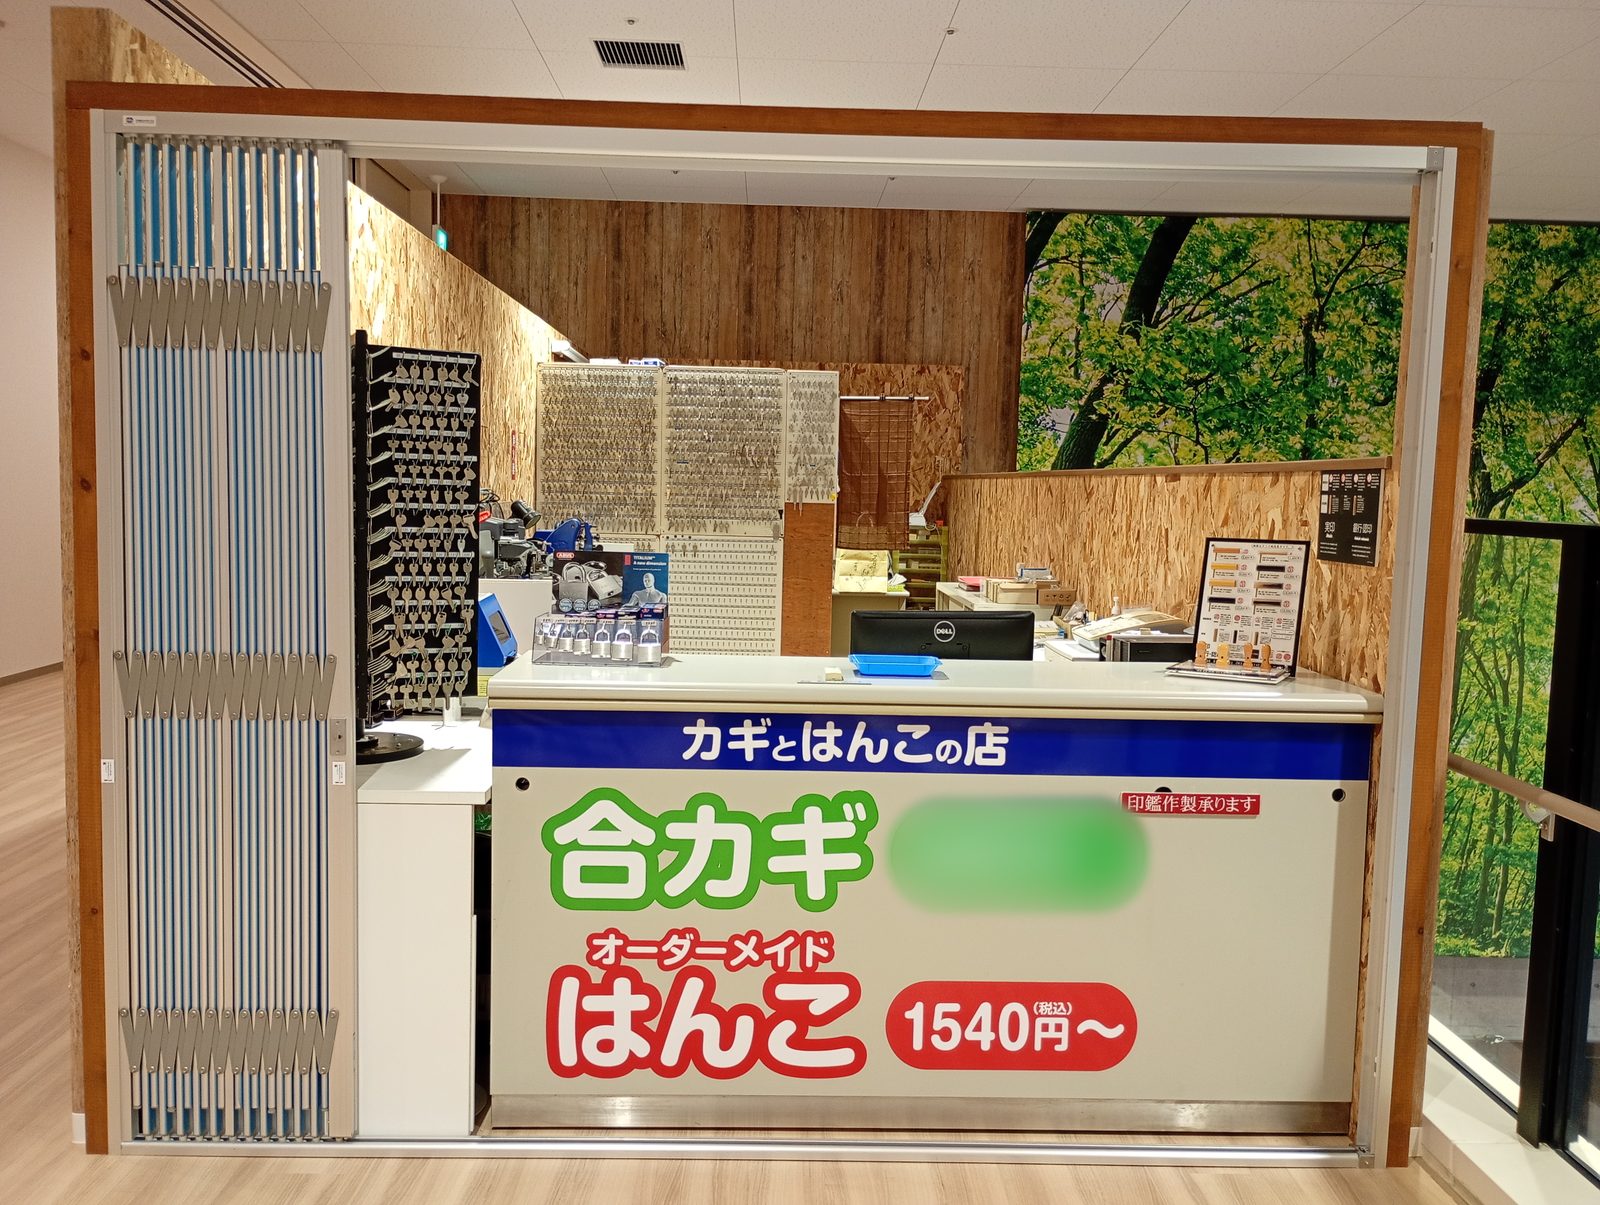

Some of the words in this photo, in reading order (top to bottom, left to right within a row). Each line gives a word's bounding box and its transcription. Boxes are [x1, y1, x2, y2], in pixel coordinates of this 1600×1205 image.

[682, 718, 1010, 766] カギとはんこの店
[1127, 795, 1257, 812] 印鑑作製承ります
[547, 793, 873, 906] 合カギ
[589, 930, 831, 969] オーダーメイド
[552, 971, 861, 1073] はんこ
